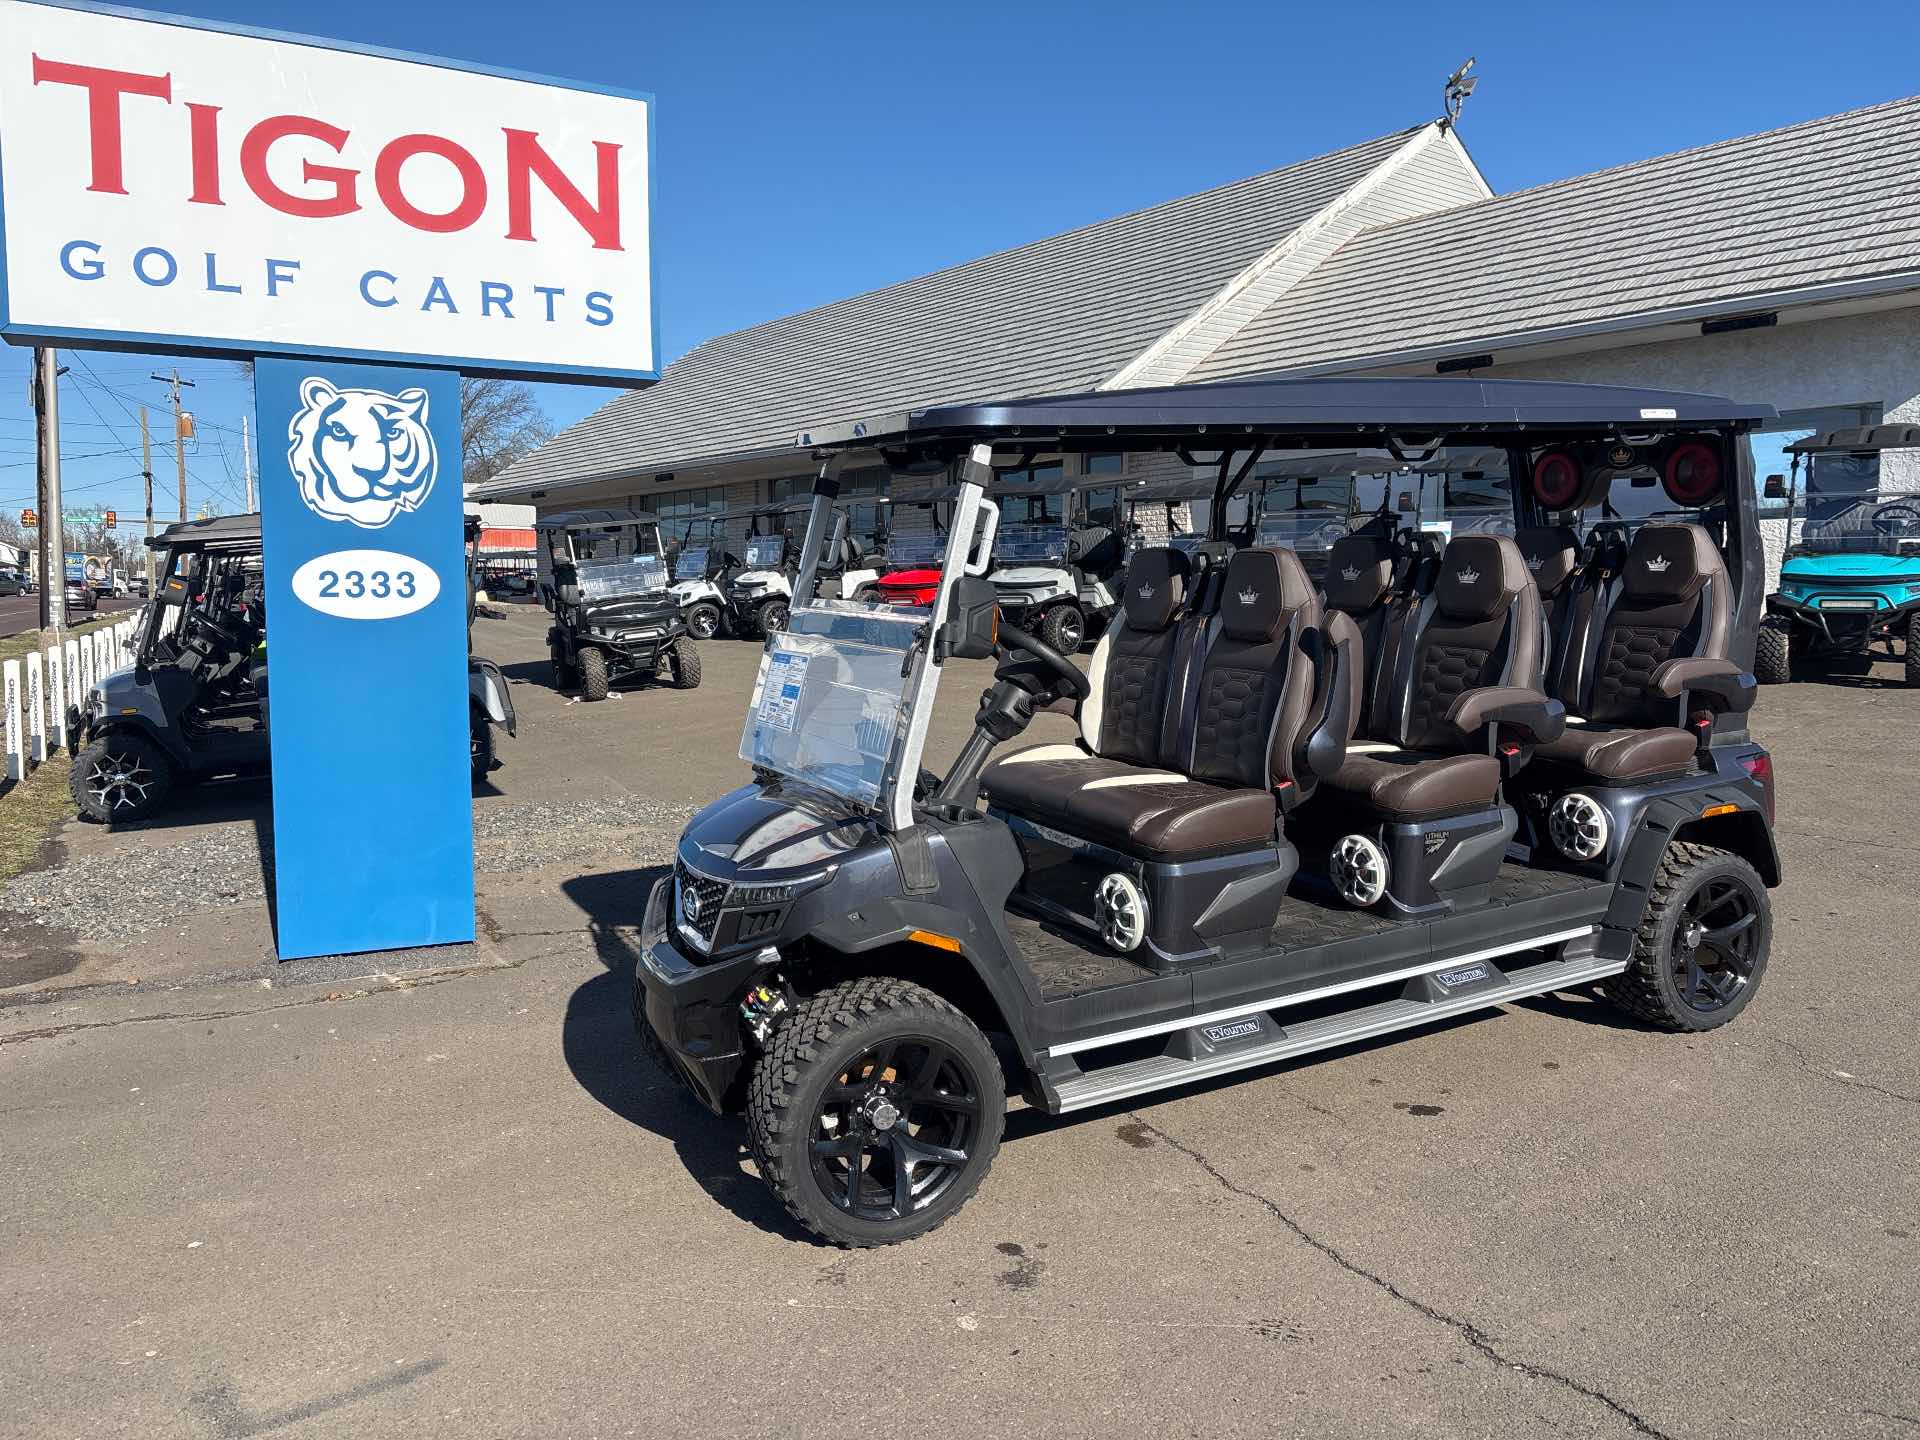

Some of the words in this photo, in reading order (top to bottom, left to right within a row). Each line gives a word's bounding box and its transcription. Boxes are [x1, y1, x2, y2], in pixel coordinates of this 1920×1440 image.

[31, 52, 625, 252] TIGON
[60, 239, 300, 298] GOLF
[359, 269, 615, 328] CARTS
[318, 570, 416, 599] 2333
[1425, 831, 1450, 842] LITHIUM
